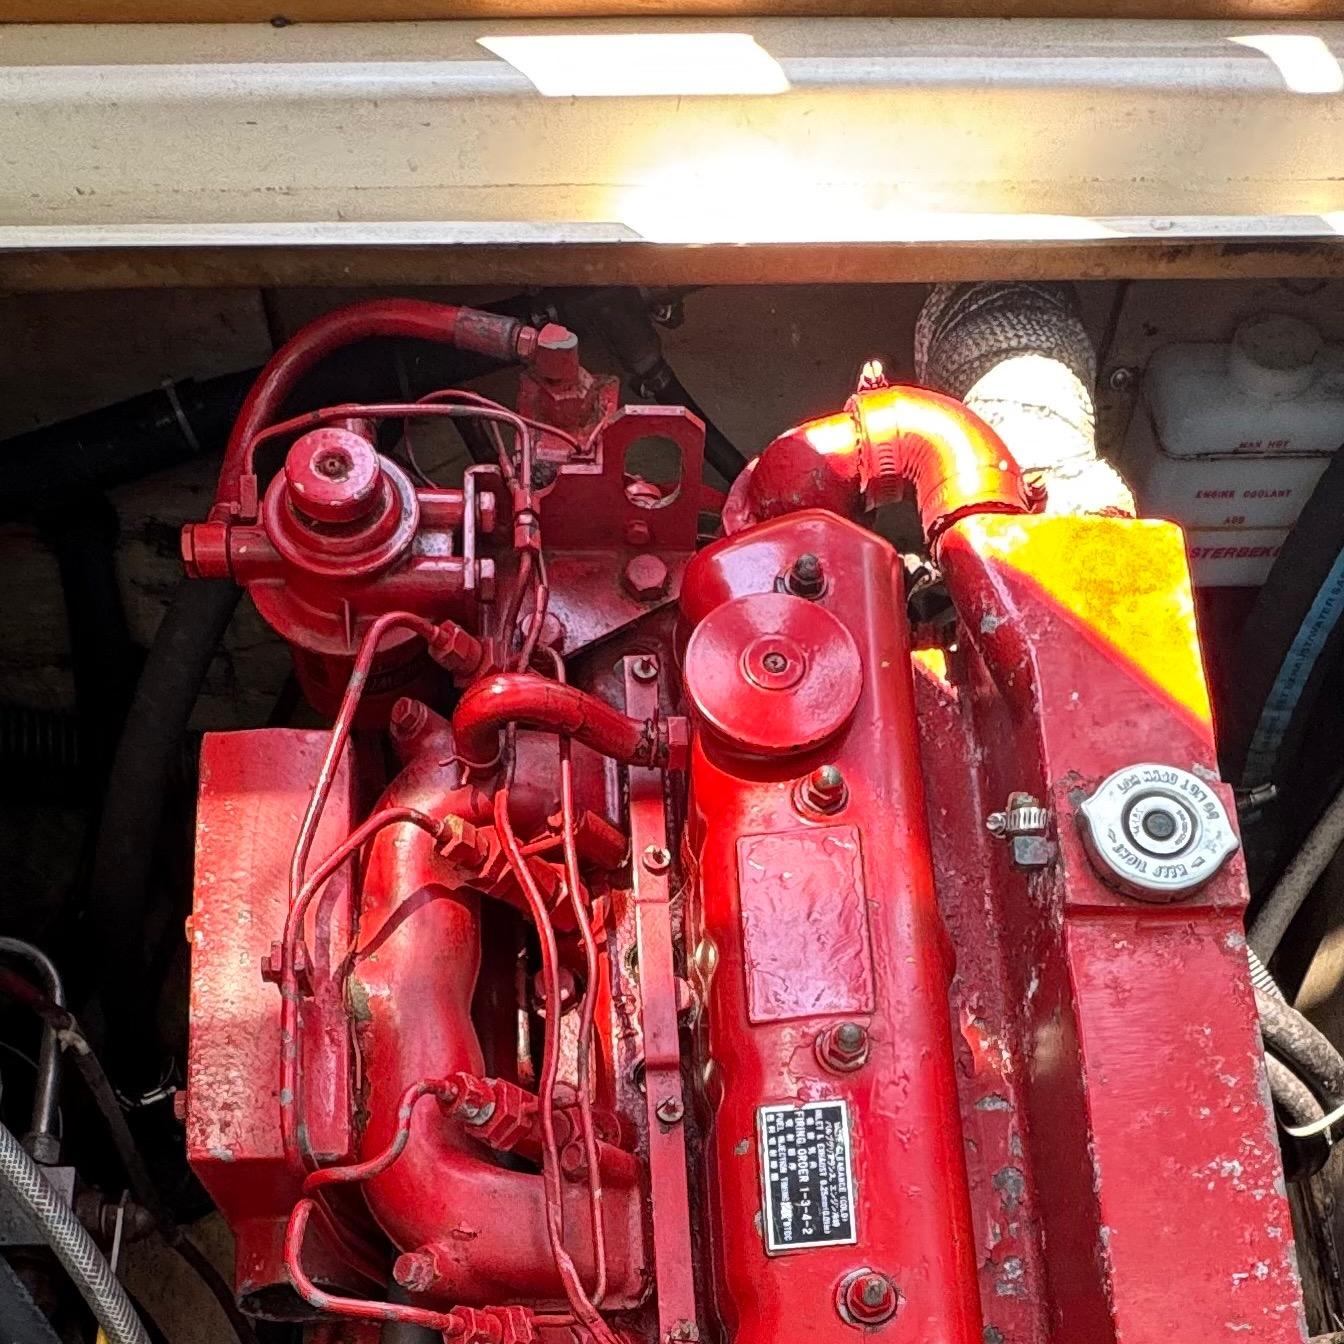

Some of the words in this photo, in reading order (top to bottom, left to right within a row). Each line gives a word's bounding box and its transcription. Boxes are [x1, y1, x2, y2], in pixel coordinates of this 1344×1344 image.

[1195, 489, 1235, 499] ENGINE
[1242, 488, 1293, 499] COOLANT
[1189, 545, 1281, 561] STERBEK
[795, 1109, 806, 1145] FIRING
[797, 1147, 809, 1183] ORDER
[799, 1186, 813, 1235] 1-3-4-2
